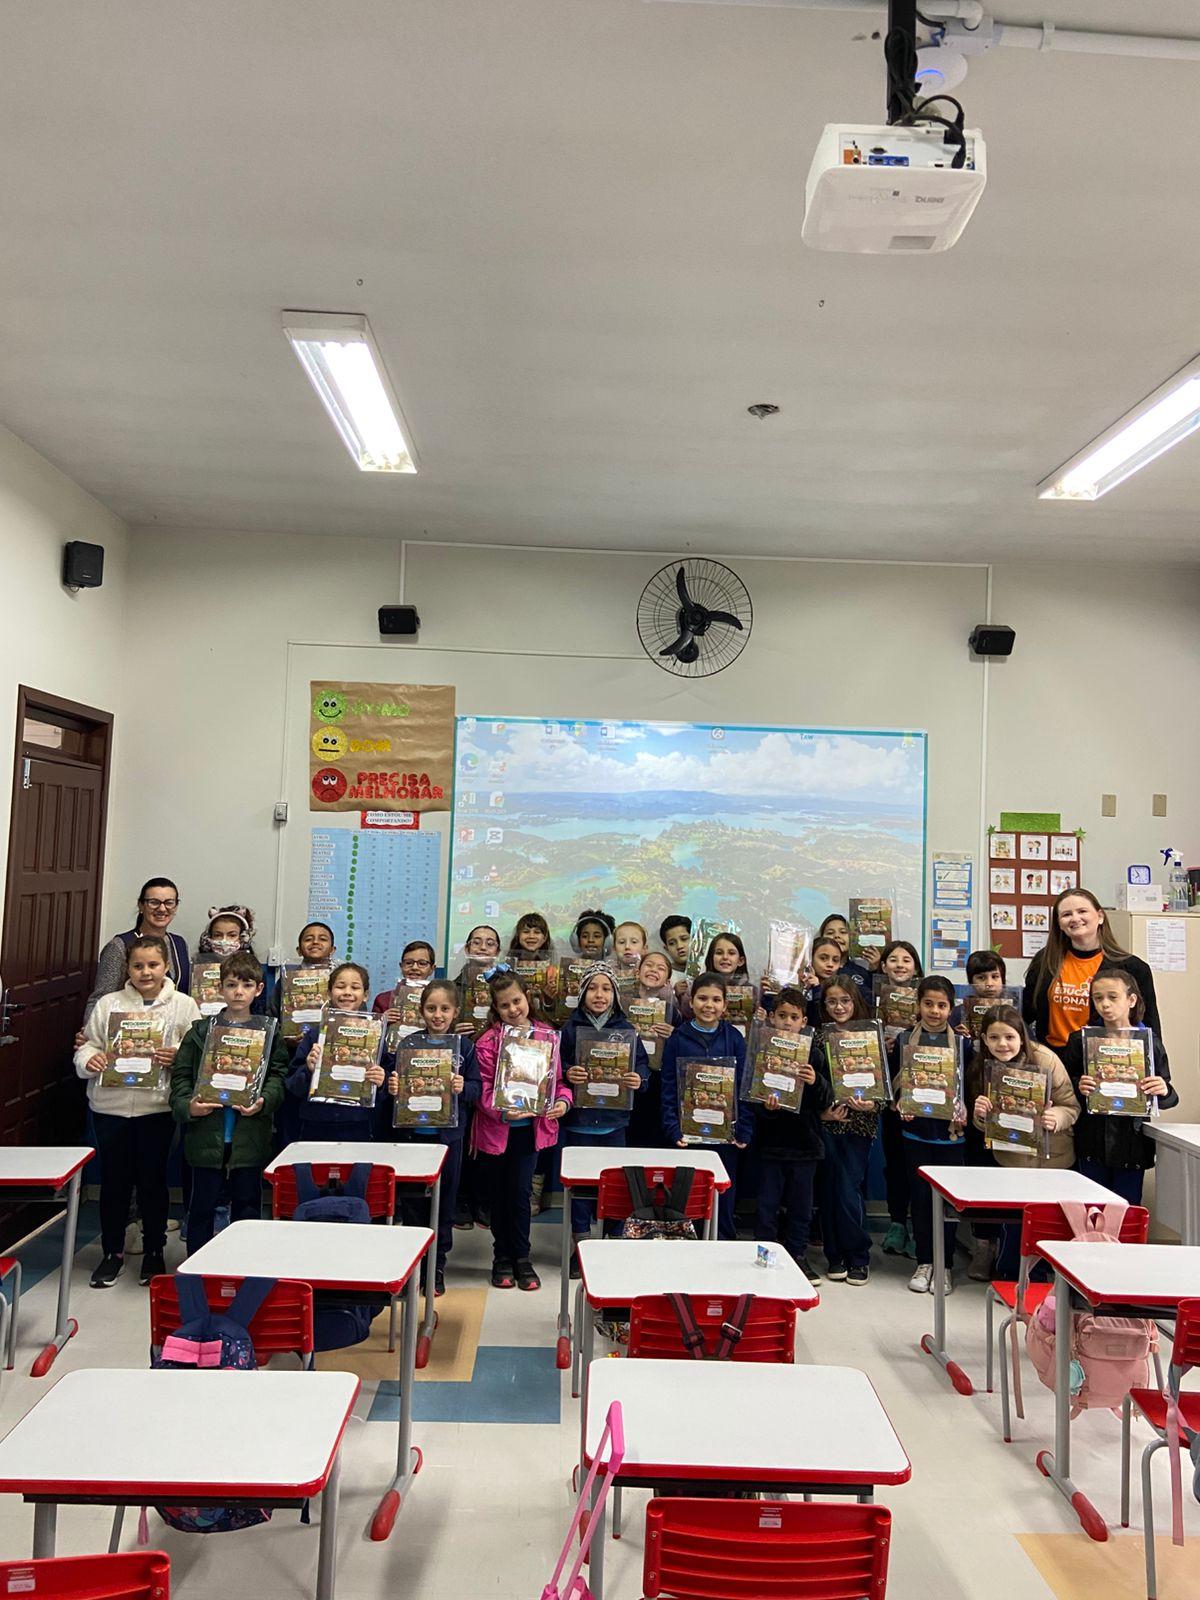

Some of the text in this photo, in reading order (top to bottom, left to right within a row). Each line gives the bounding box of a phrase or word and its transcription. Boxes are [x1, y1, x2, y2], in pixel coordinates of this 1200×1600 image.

[350, 738, 391, 752] BOM
[357, 772, 431, 787] PRECISA
[349, 784, 444, 800] MELHORAR
